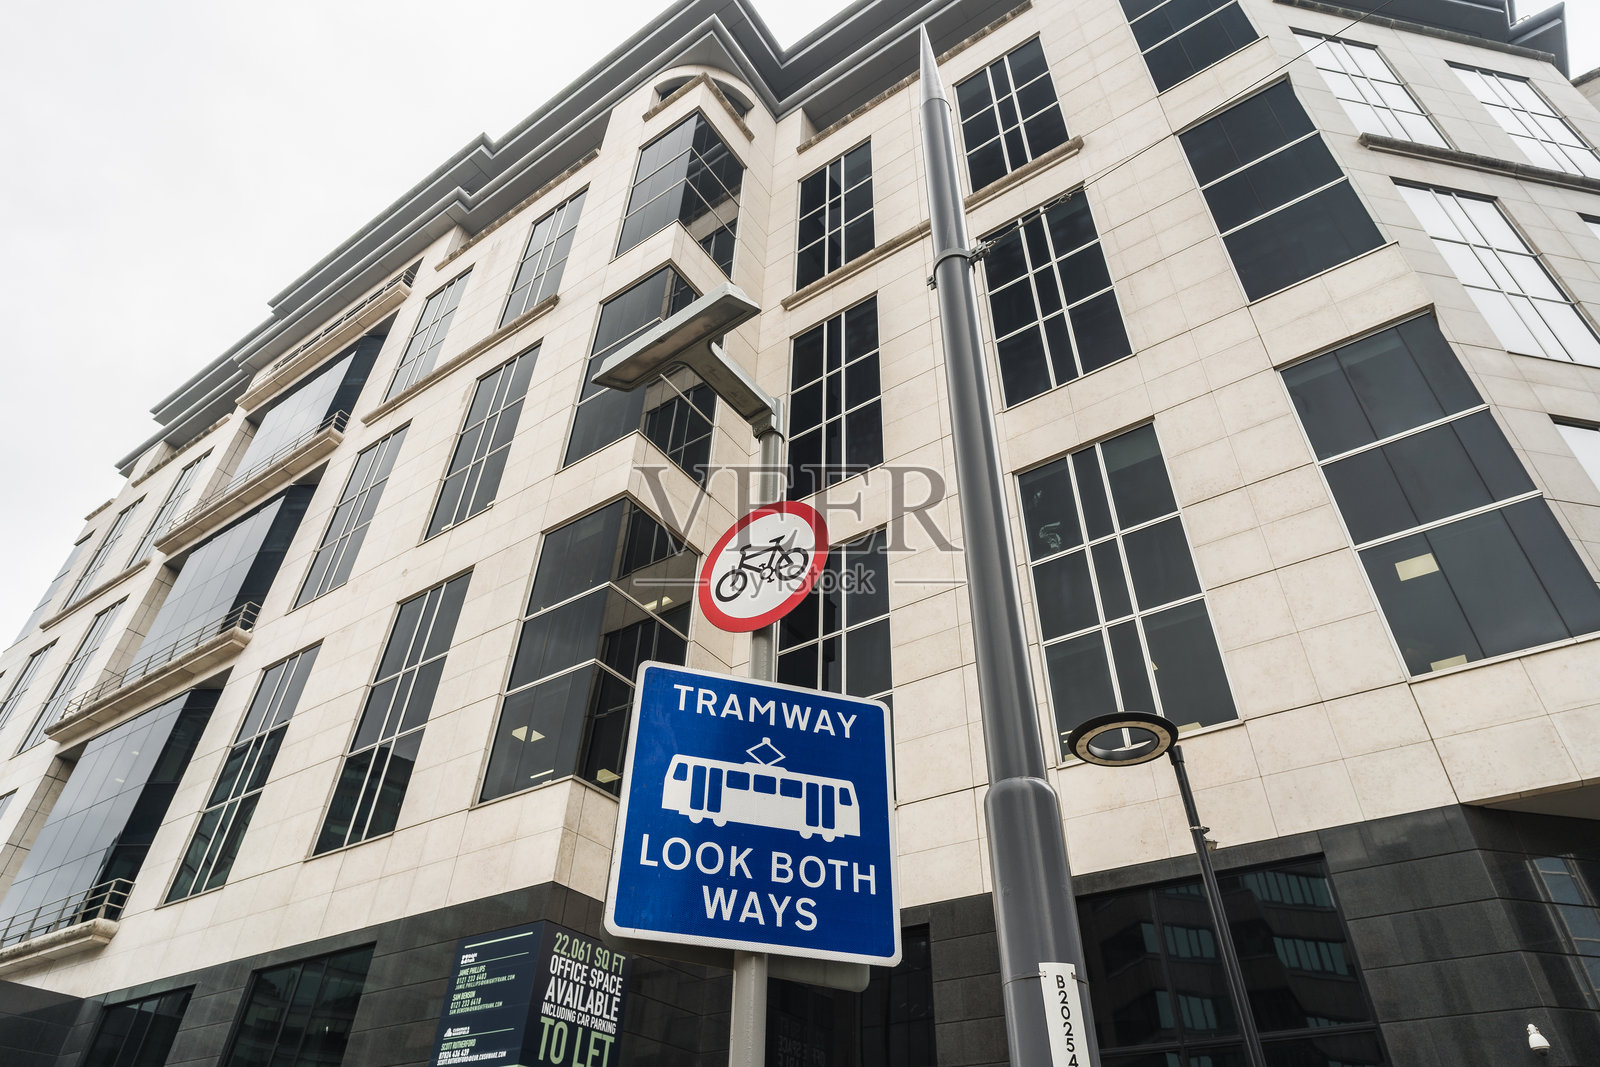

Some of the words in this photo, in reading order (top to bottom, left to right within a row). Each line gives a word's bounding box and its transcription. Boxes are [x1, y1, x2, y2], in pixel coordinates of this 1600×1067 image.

[673, 684, 857, 739] TRAMWAY
[639, 833, 754, 879] LOOK
[771, 851, 876, 895] BOTH
[702, 885, 818, 931] WAYS
[549, 954, 589, 985] OFFICE
[589, 968, 624, 997] SPACE
[553, 932, 592, 963] 22,061
[594, 946, 610, 971] SQ
[612, 953, 626, 975] FT
[541, 1001, 577, 1023] INCLUDING
[577, 1012, 590, 1028] CAR
[590, 1016, 617, 1035] PARKING
[544, 976, 621, 1022] AVAILABLE
[1056, 974, 1079, 1067] B20254
[538, 1016, 569, 1065] TO
[572, 1027, 616, 1067] LET
